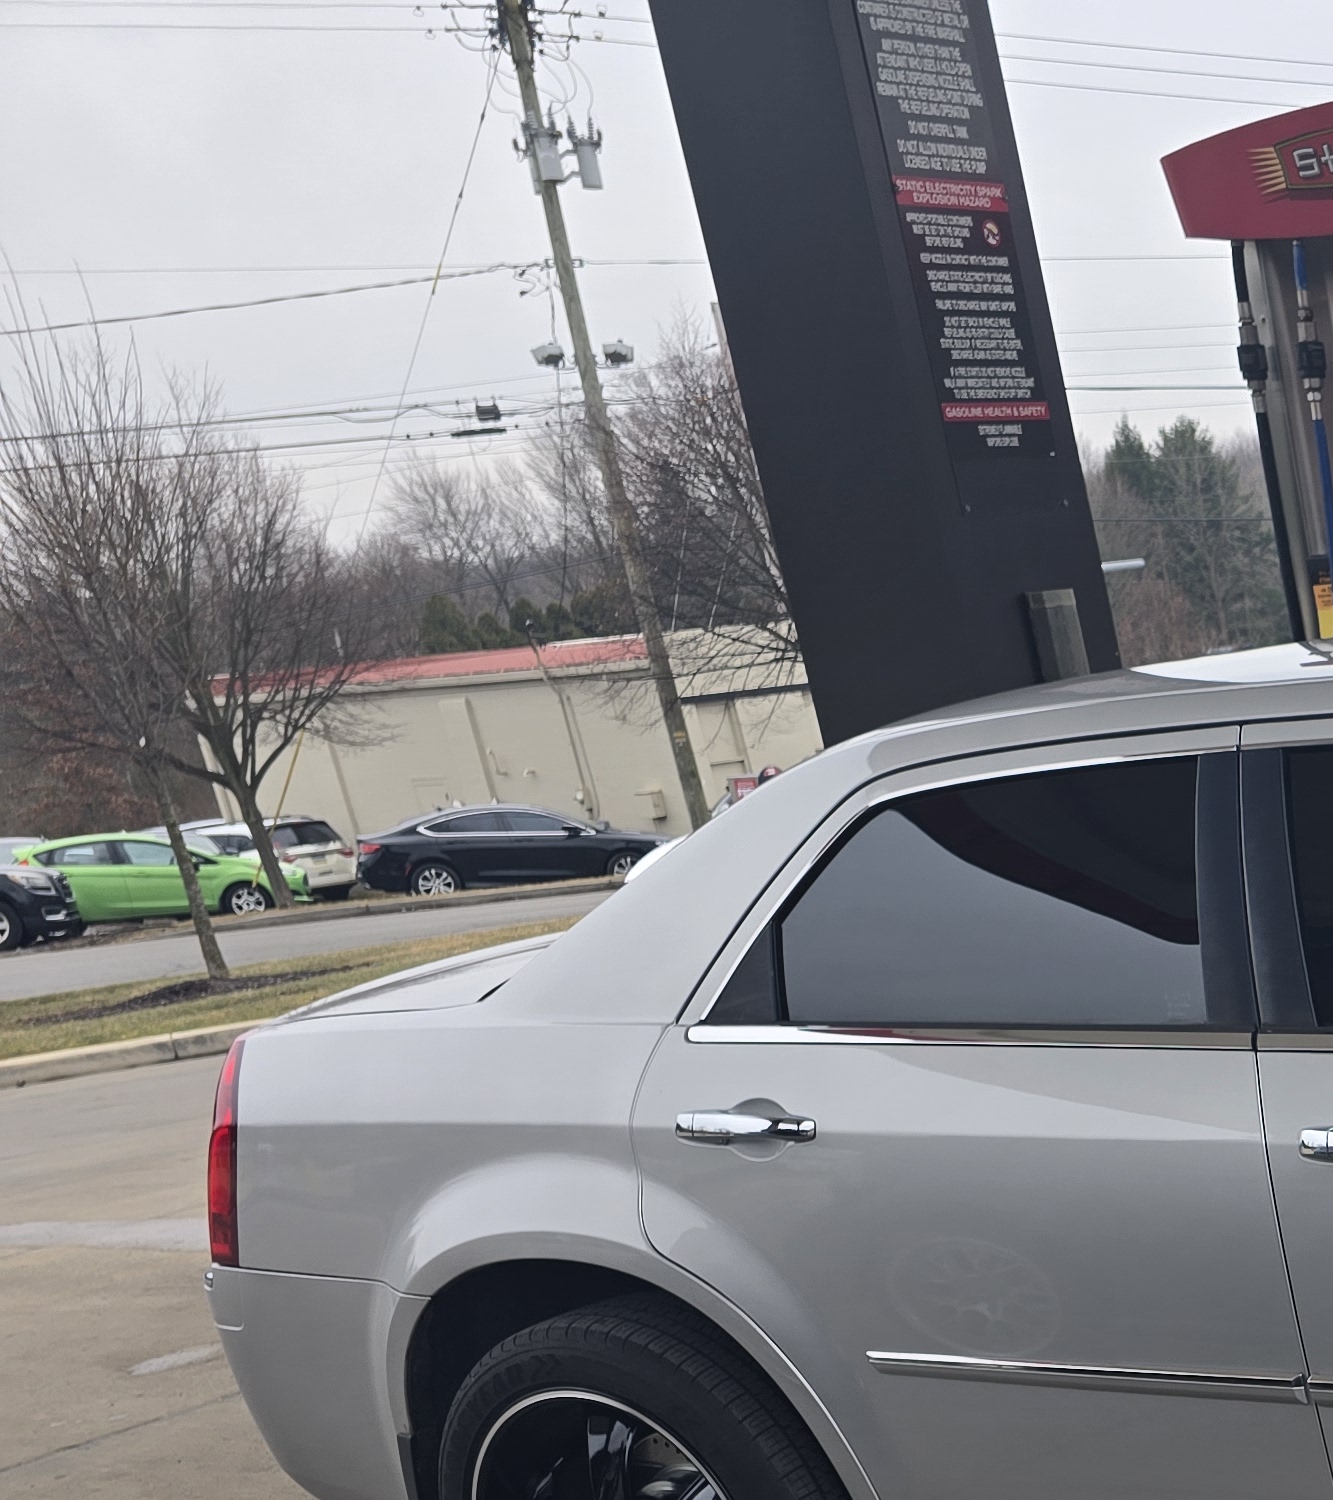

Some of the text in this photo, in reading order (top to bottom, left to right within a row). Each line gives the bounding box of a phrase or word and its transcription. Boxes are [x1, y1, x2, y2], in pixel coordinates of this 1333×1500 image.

[896, 180, 1002, 198] STATIC ELECTRICITY SPARK
[913, 191, 992, 208] EXPLOSION HAZARD
[945, 406, 984, 418] GASOLINE
[984, 405, 1013, 417] HEALTH
[1019, 405, 1046, 417] SAFETY
